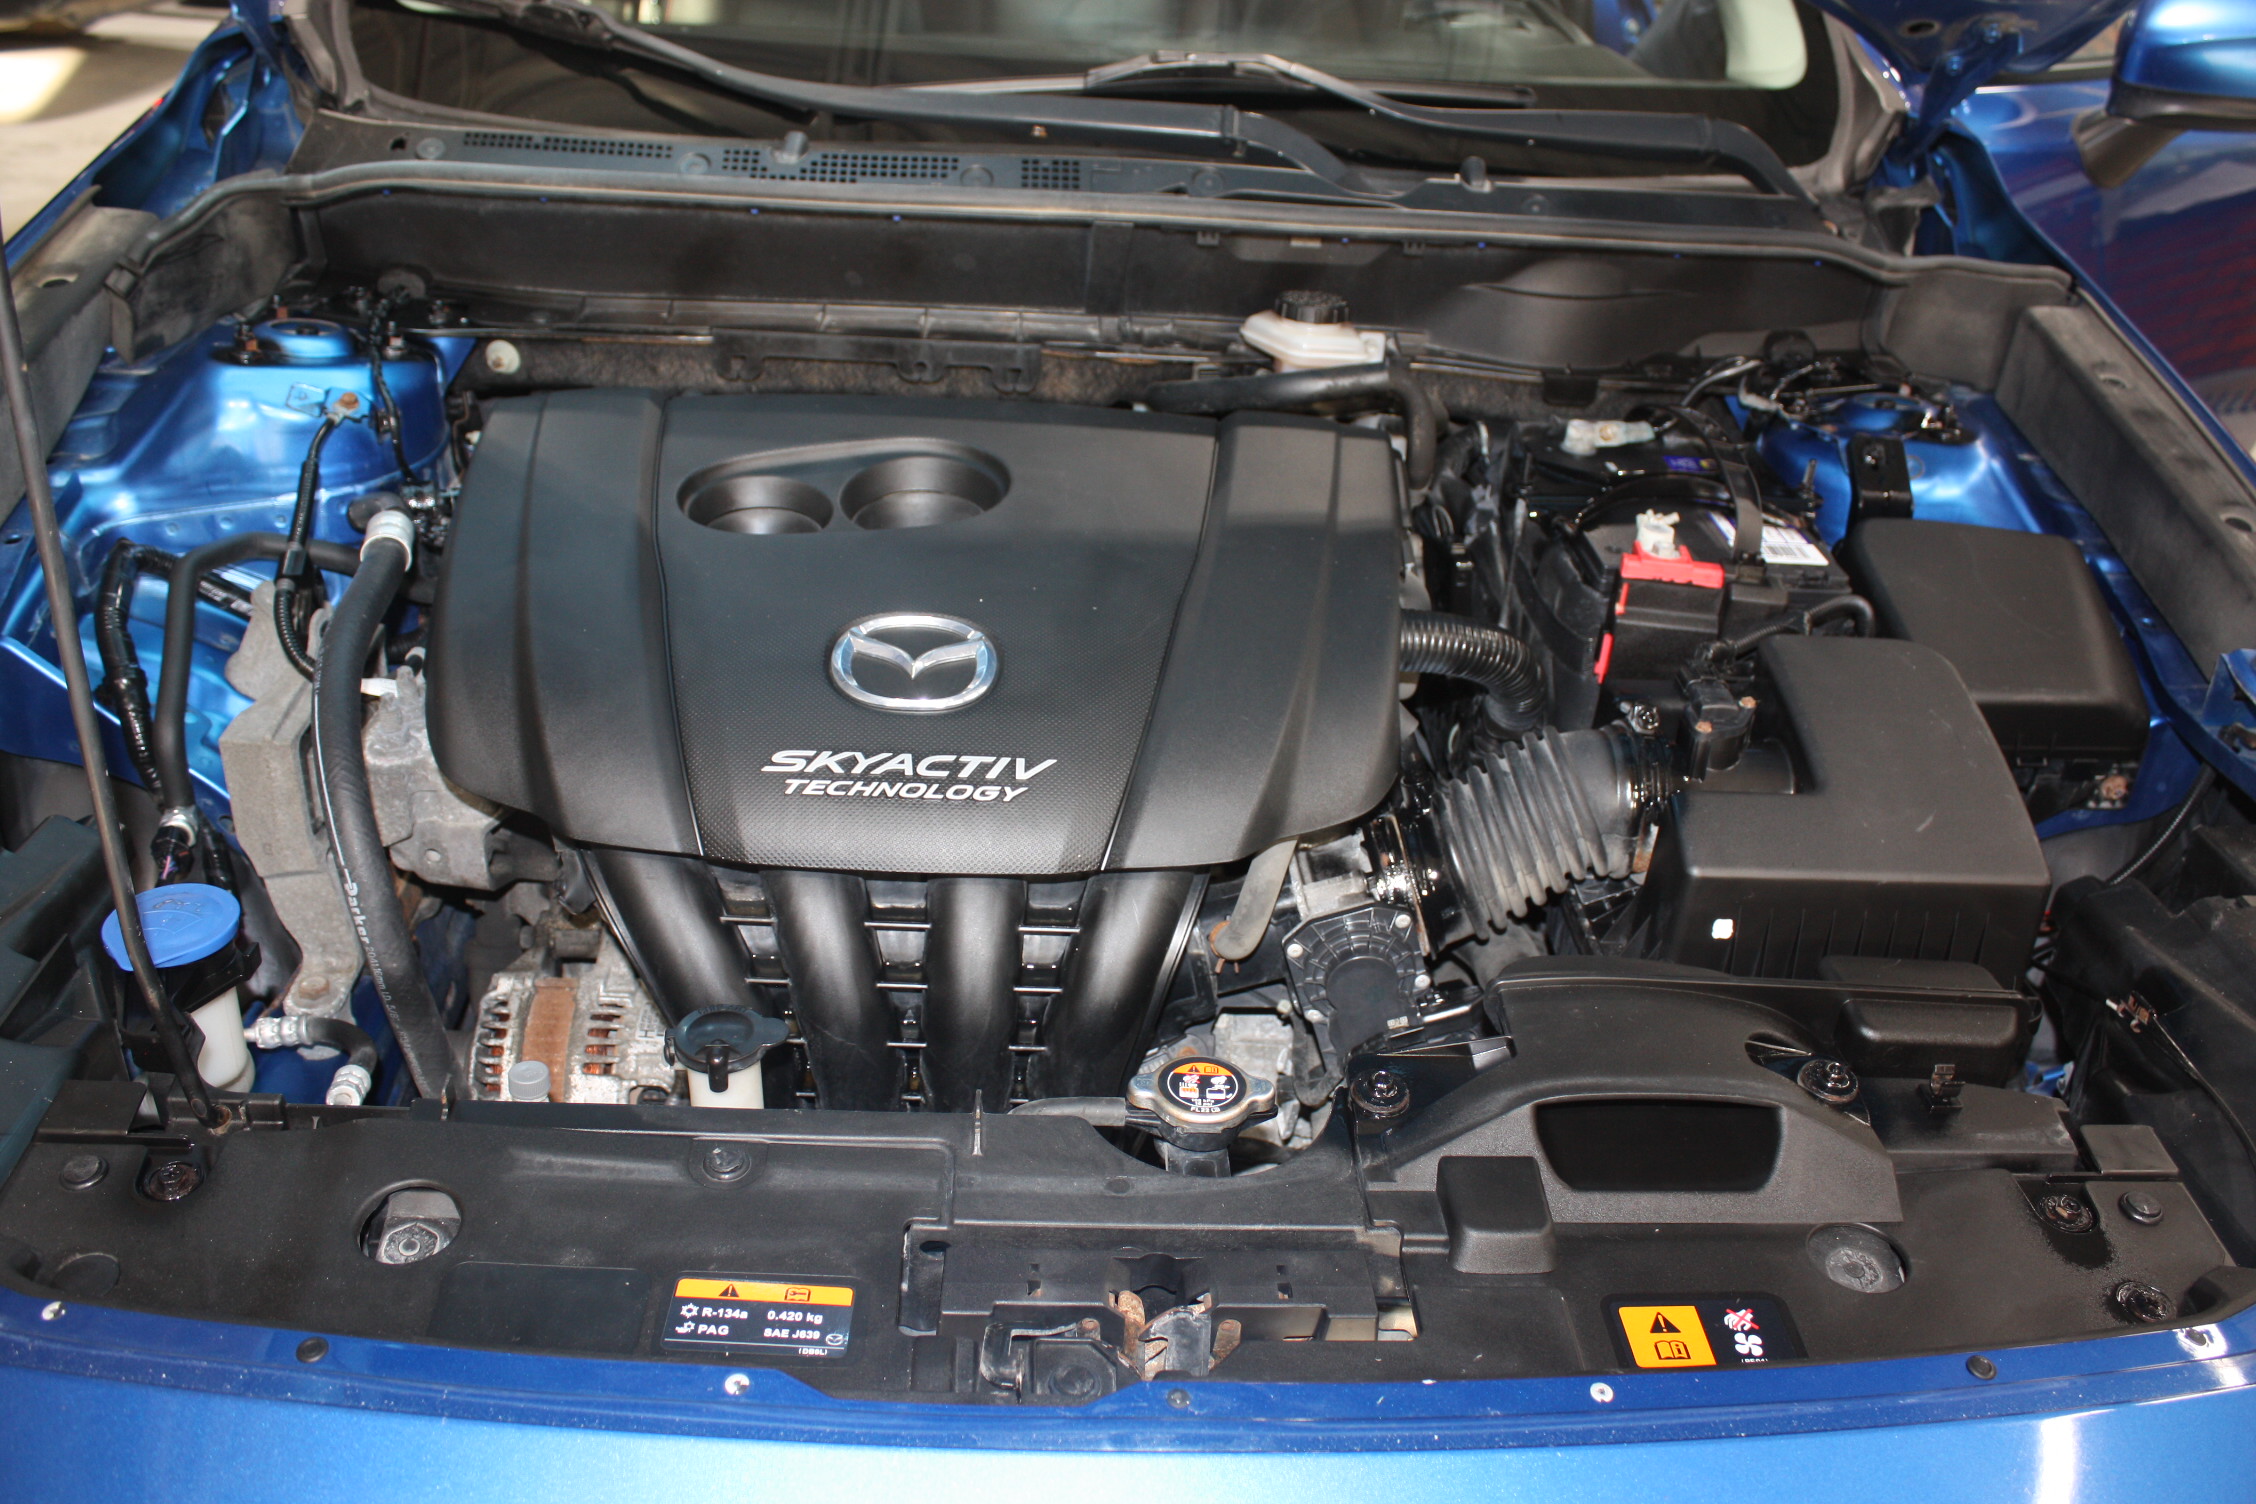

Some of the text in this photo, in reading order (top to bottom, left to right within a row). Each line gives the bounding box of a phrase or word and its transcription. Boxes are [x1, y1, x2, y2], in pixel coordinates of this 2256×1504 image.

[760, 749, 1058, 781] SKYACTIV
[784, 778, 1029, 803] TECHNOLOGY
[344, 882, 369, 943] Parker
[701, 1307, 823, 1324] R-134a 0.420 kg
[697, 1324, 821, 1340] PAG SAE J639
